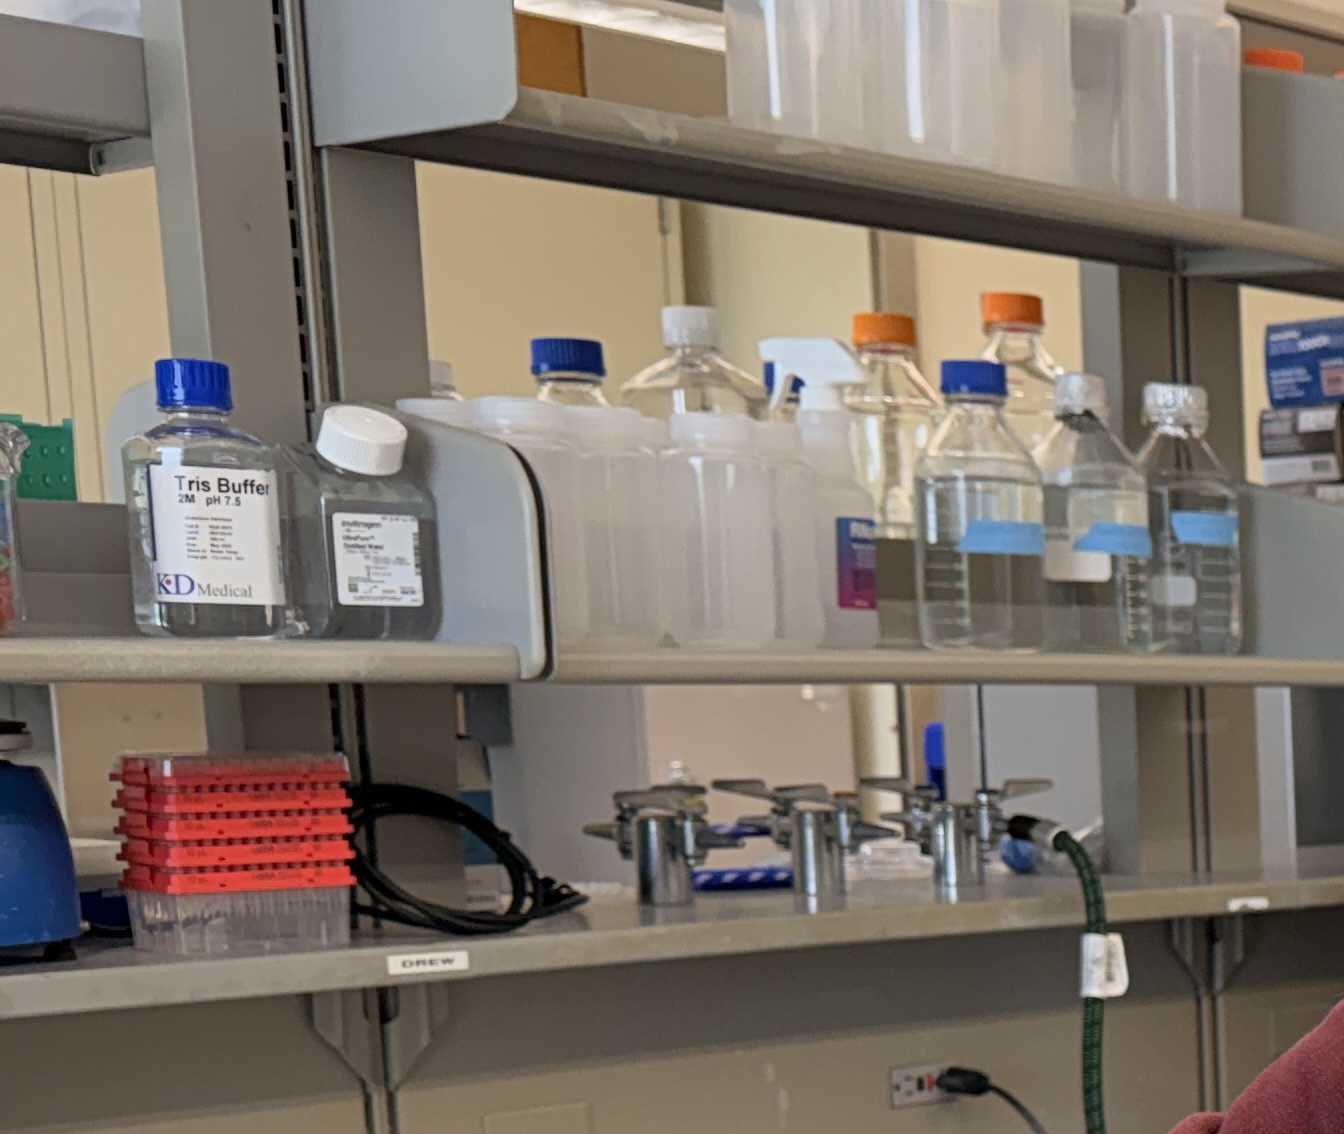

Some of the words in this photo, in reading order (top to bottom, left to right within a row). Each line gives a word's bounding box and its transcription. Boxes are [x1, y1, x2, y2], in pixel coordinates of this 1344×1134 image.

[174, 475, 211, 492] Tris
[217, 477, 270, 496] Buffer
[178, 494, 195, 504] 2M
[206, 495, 221, 507] pH
[224, 495, 241, 507] 7.5
[197, 583, 253, 598] Medical
[401, 957, 455, 969] DREW
